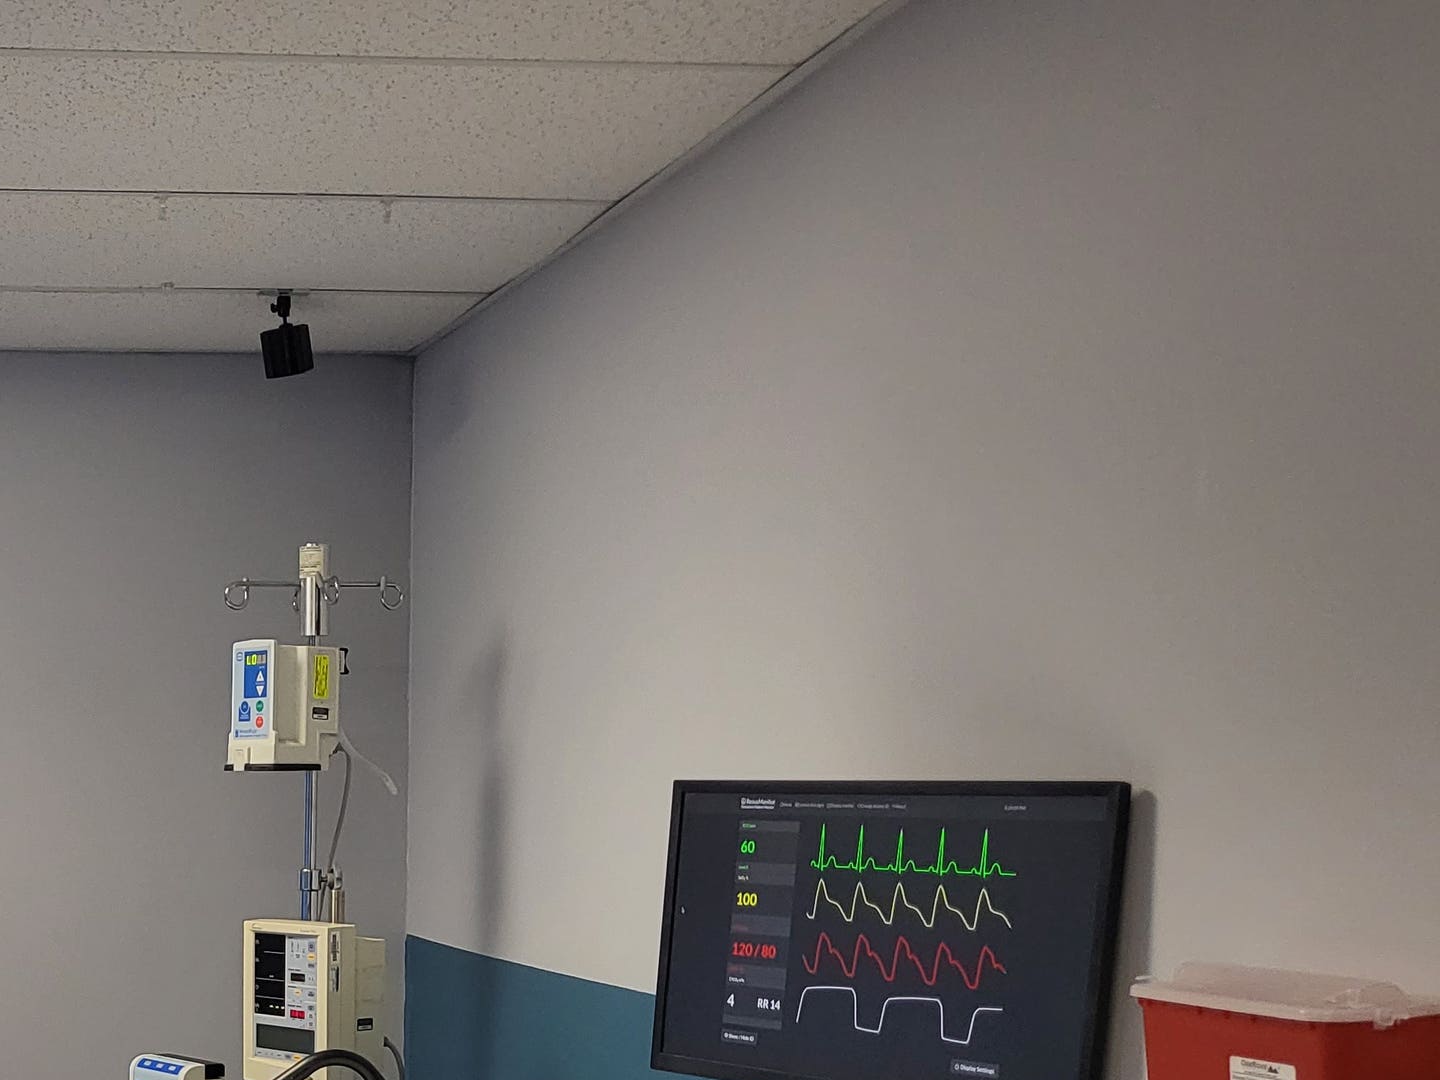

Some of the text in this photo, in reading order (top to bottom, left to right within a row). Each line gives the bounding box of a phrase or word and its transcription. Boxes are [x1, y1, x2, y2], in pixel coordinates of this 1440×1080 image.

[740, 840, 756, 854] 60
[736, 892, 758, 906] 100
[732, 942, 753, 957] 120
[761, 944, 777, 959] 80
[726, 993, 781, 1011] 4 RR 14
[960, 1064, 995, 1075] Display Settings
